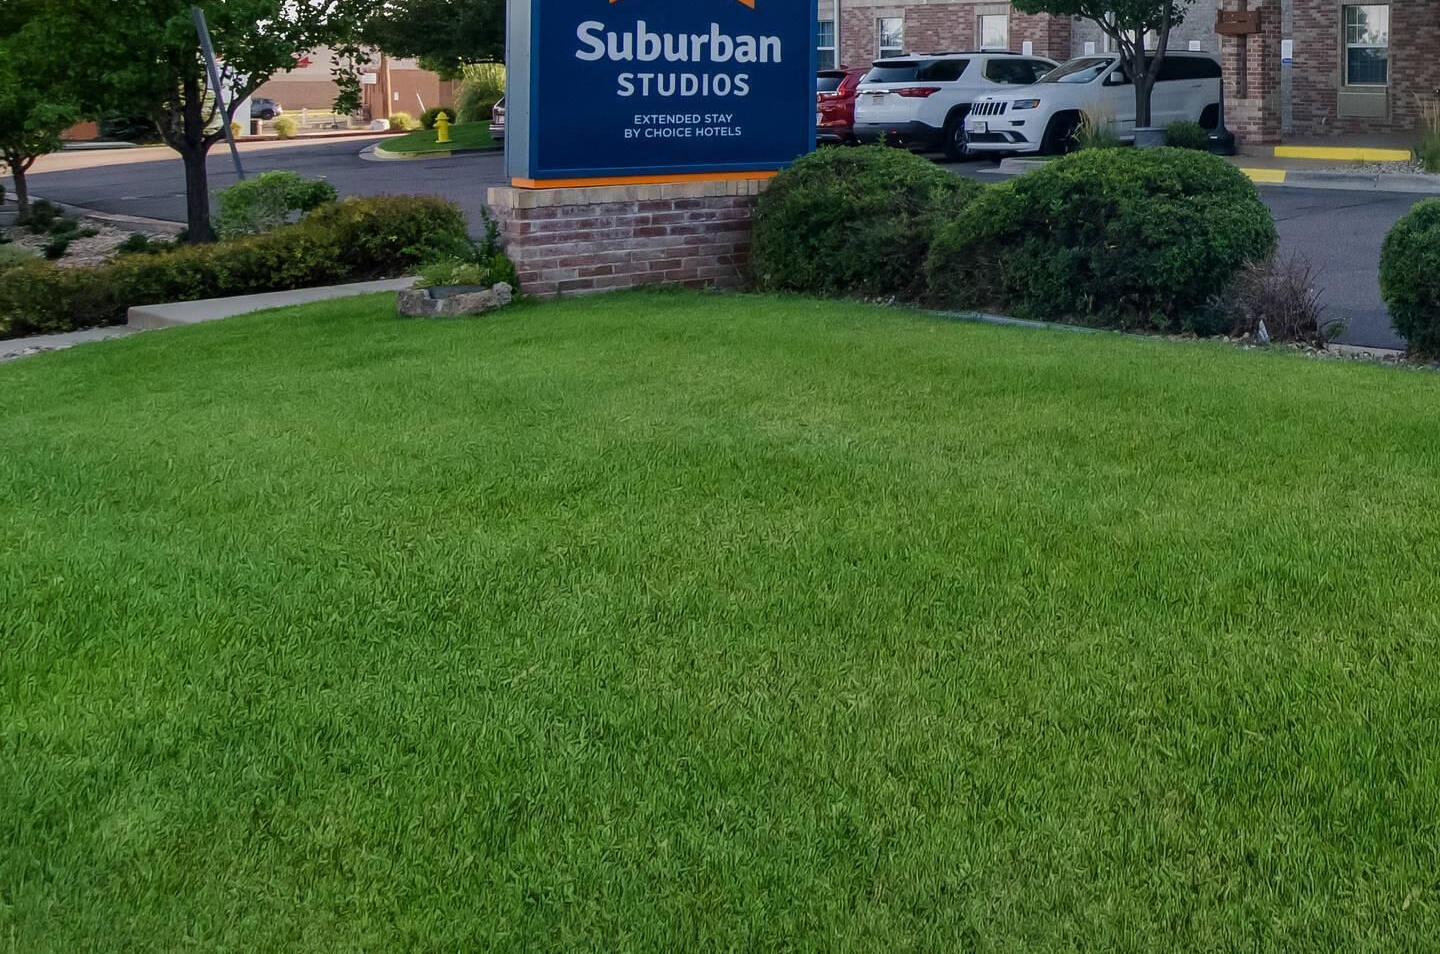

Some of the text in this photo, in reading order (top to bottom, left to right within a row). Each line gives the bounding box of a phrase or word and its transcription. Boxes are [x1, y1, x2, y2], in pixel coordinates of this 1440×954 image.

[575, 20, 782, 63] Suburban
[617, 73, 749, 96] STUDIOS
[634, 114, 733, 124] EXTENDED STAY
[624, 127, 741, 139] BY CHOICE HOTELS
